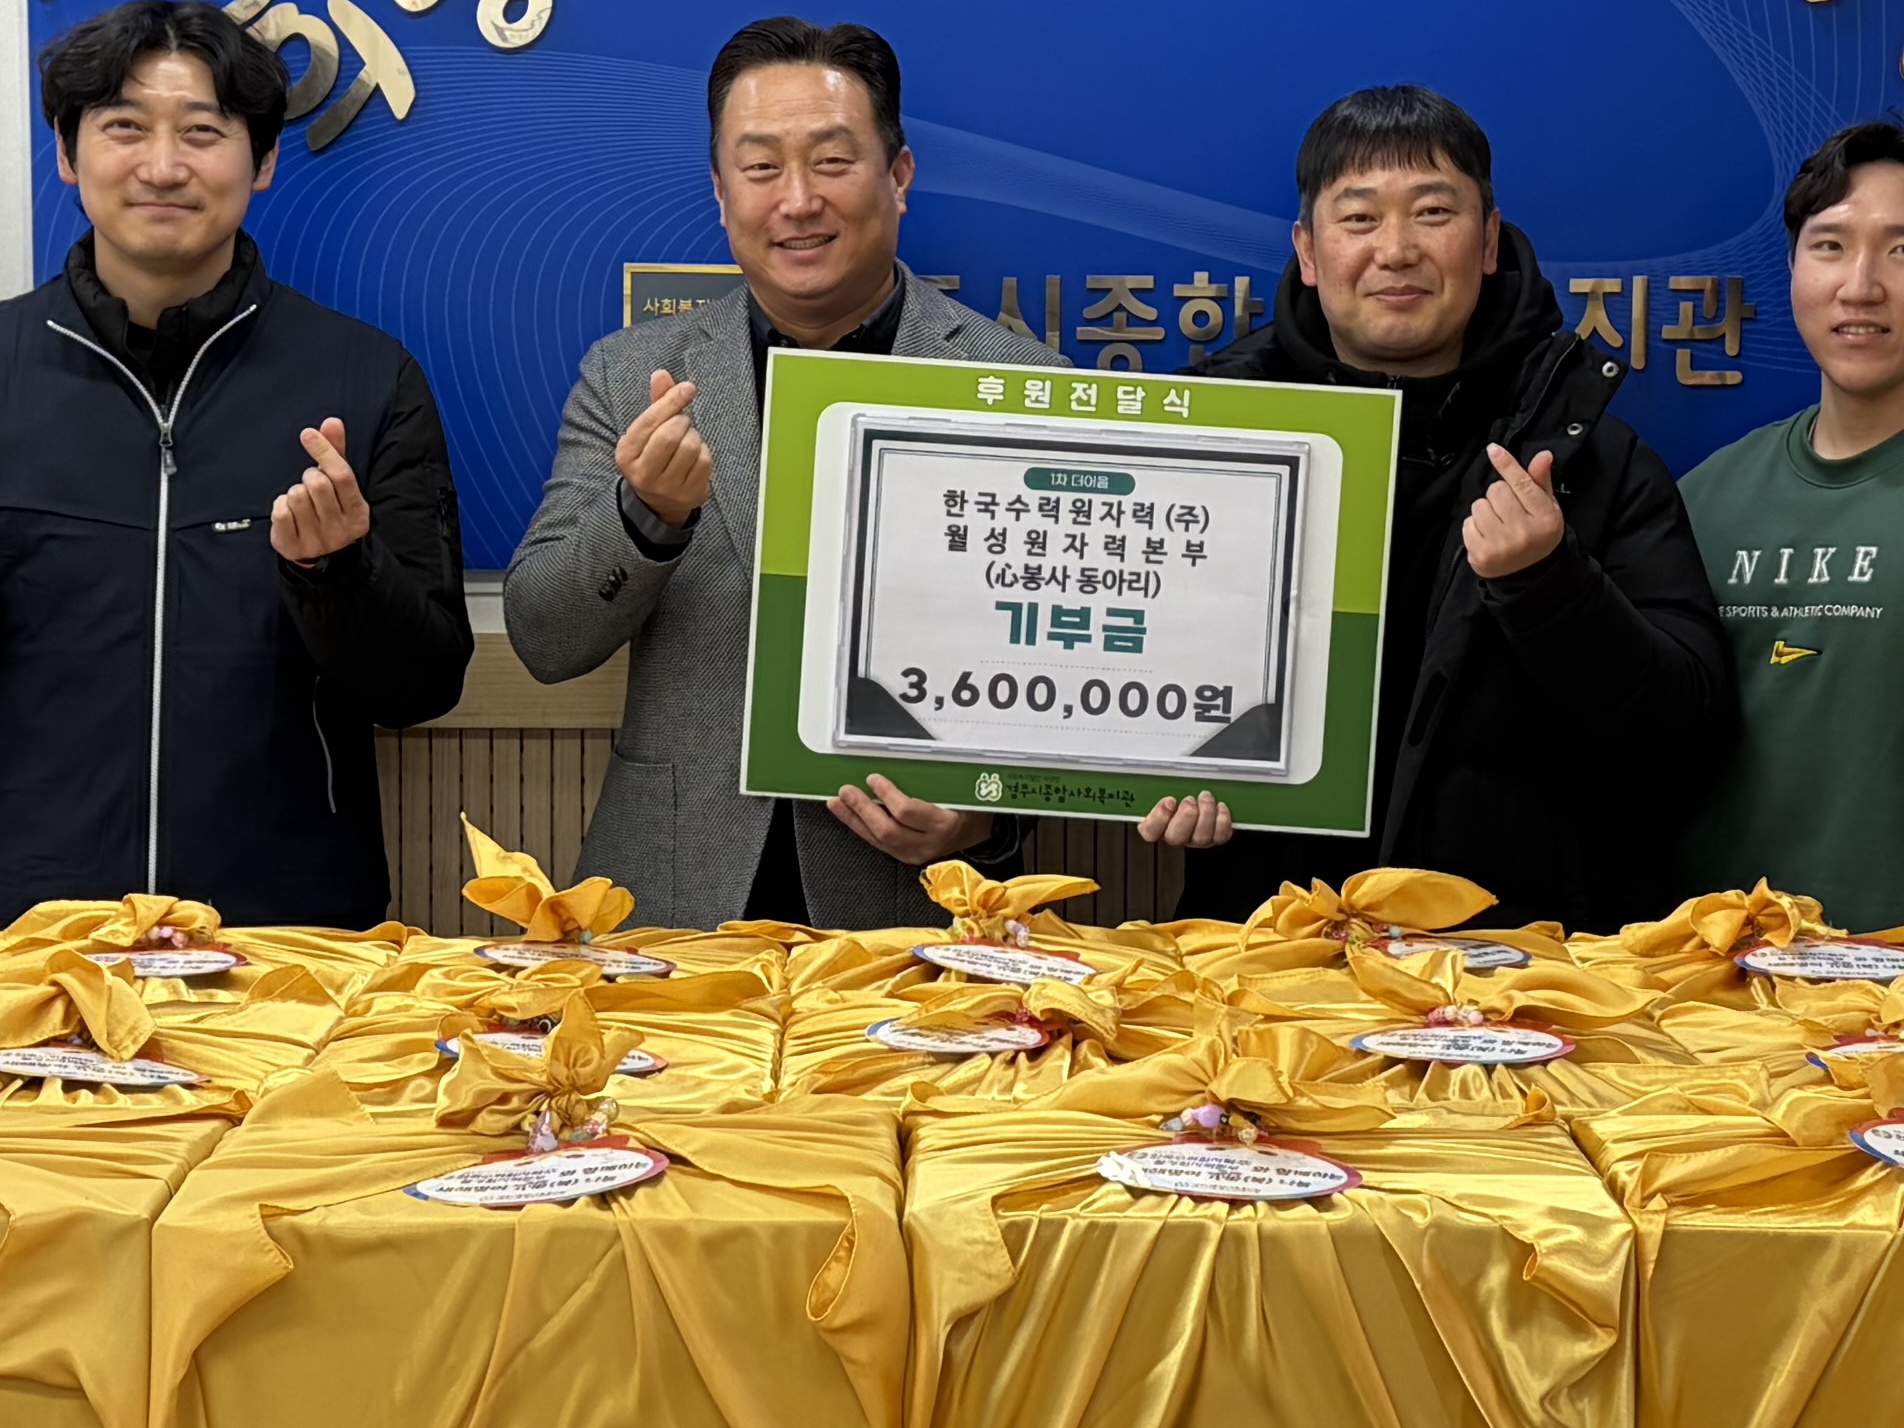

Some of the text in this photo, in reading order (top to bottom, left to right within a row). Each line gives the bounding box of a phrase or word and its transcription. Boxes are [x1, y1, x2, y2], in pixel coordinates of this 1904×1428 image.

[976, 375, 1192, 419] 후원전달식
[985, 561, 1162, 599] (心봉사 동아리)
[1727, 545, 1879, 585] NIKE
[994, 600, 1149, 655] 기부금
[1824, 604, 1884, 619] COMPANY
[898, 667, 1233, 725] 3,600,000원
